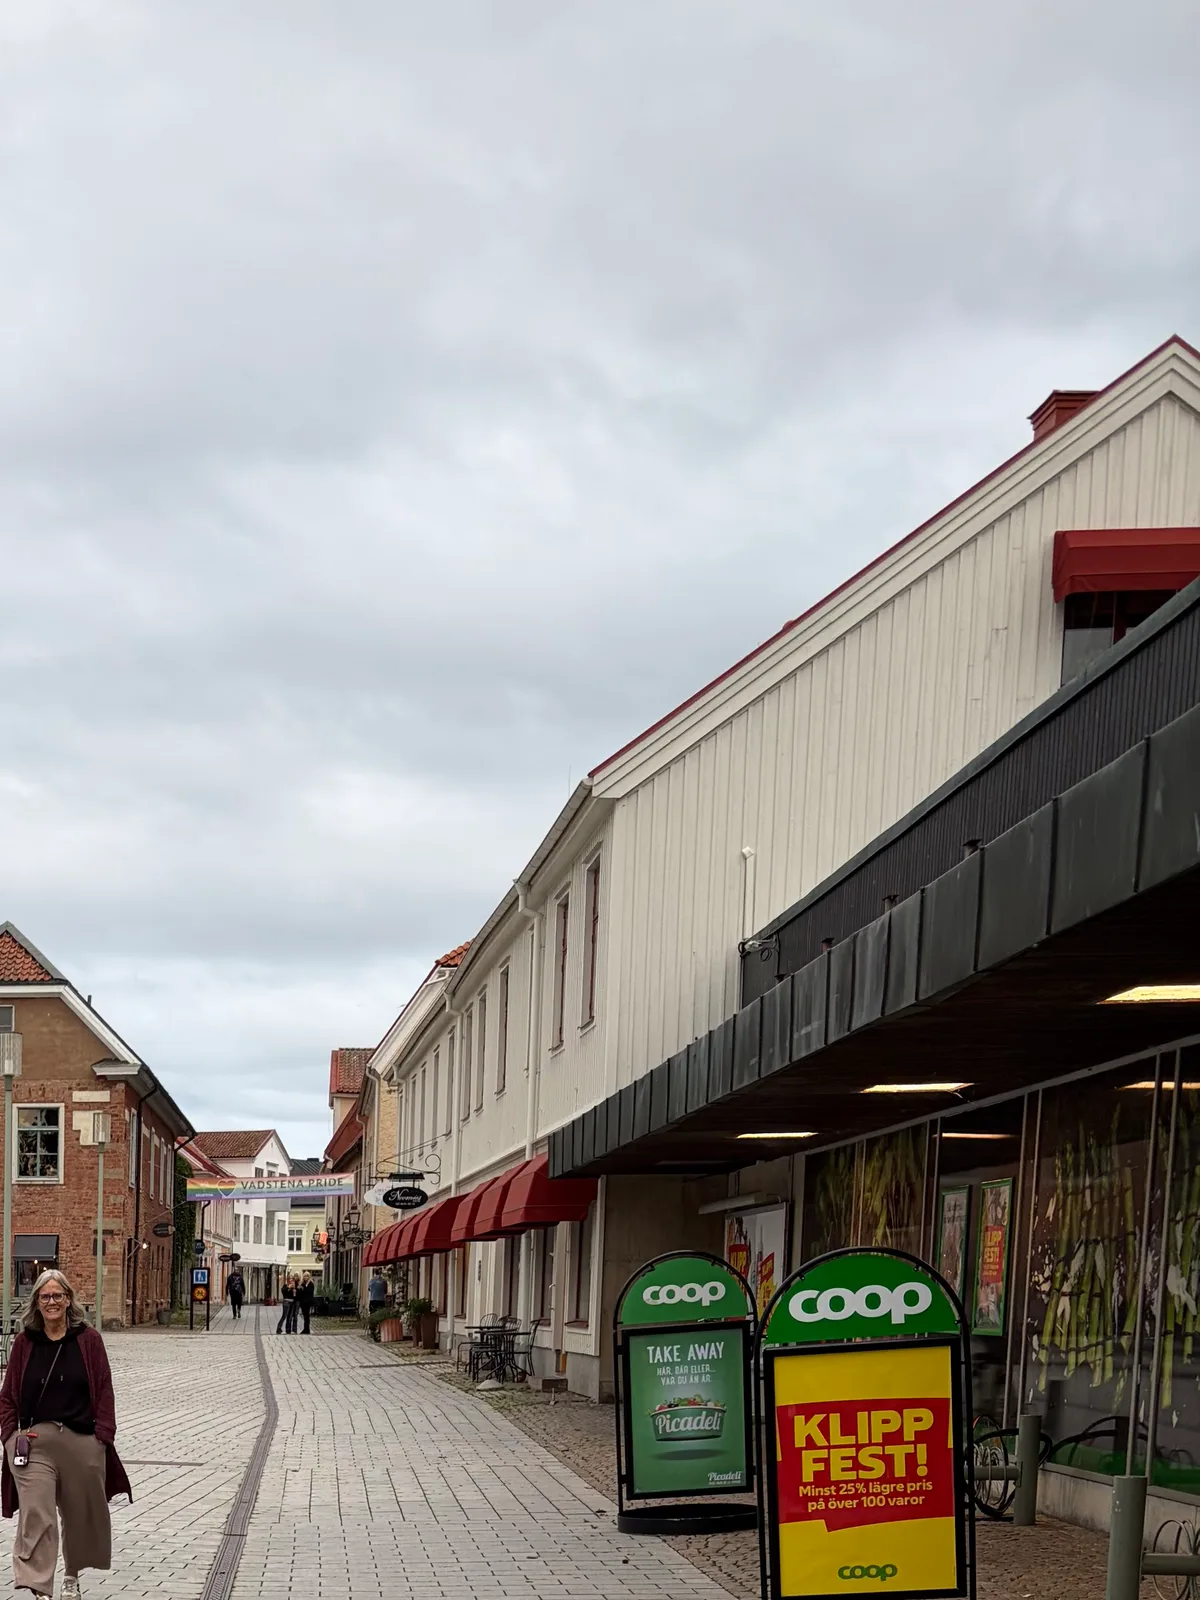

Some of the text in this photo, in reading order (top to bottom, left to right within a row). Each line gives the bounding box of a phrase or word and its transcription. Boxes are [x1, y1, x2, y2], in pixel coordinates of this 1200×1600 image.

[241, 1177, 344, 1190] VADSTENA PRIDE
[642, 1281, 726, 1307] coop
[788, 1282, 932, 1324] coop
[647, 1342, 724, 1364] TAKE AWAY
[661, 1377, 675, 1386] VAR
[677, 1377, 687, 1385] DU
[655, 1411, 722, 1435] Picadeli
[794, 1408, 934, 1448] KLIPP
[802, 1443, 928, 1482] FEST!
[707, 1471, 741, 1481] Picadeli
[798, 1479, 933, 1497] Minst 25% lägre pris
[807, 1495, 926, 1512] på över 100 varor
[837, 1563, 898, 1582] coop
